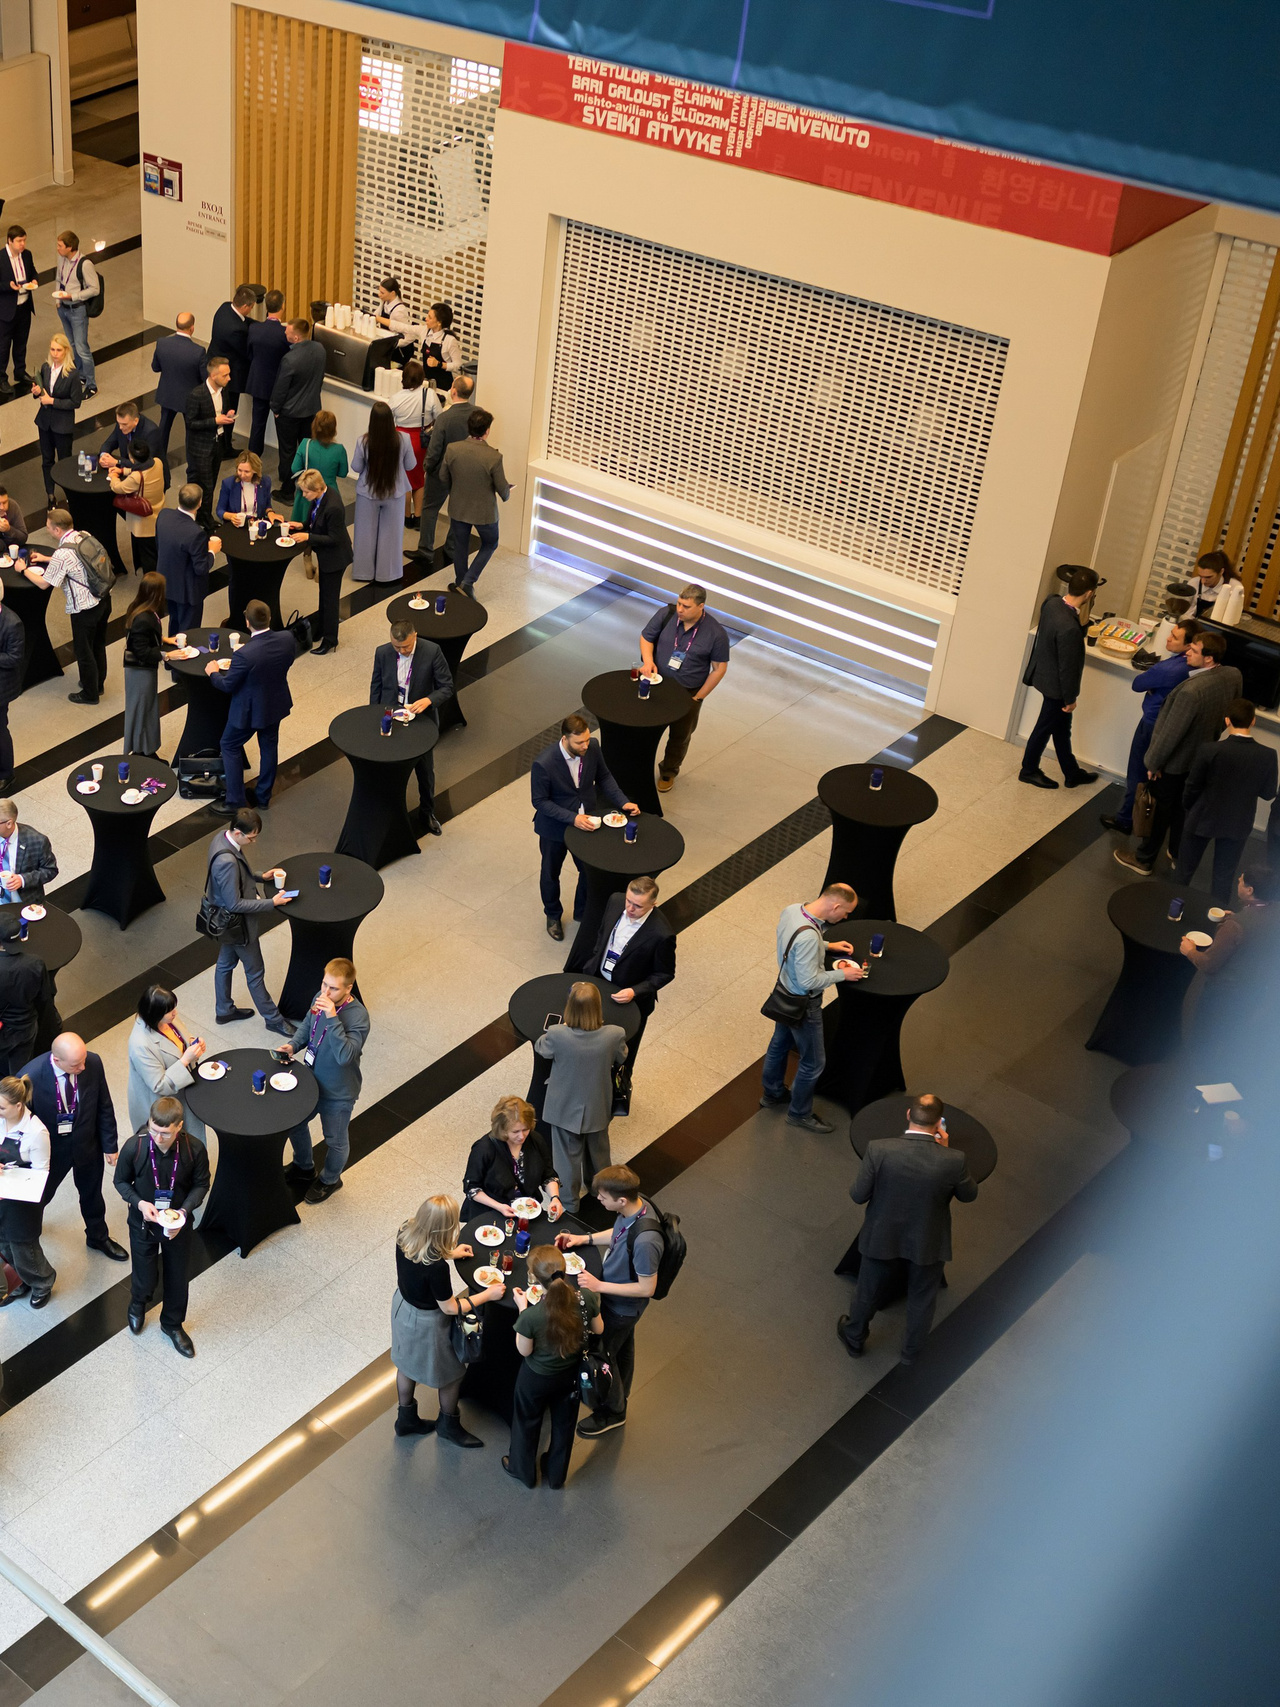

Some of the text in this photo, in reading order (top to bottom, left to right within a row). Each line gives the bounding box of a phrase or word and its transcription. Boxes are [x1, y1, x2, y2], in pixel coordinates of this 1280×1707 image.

[567, 54, 650, 86] TERVETULOA
[572, 75, 671, 109] BARI GALOUST
[574, 93, 654, 119] mishto-avilian
[684, 90, 724, 112] LAIPNI
[582, 105, 723, 156] SVEIKI ATVYKE
[681, 107, 730, 132] LŪDZAM
[764, 108, 870, 149] BENVENUTO
[725, 126, 737, 157] SVEIKI
[201, 201, 223, 216] ВХОД
